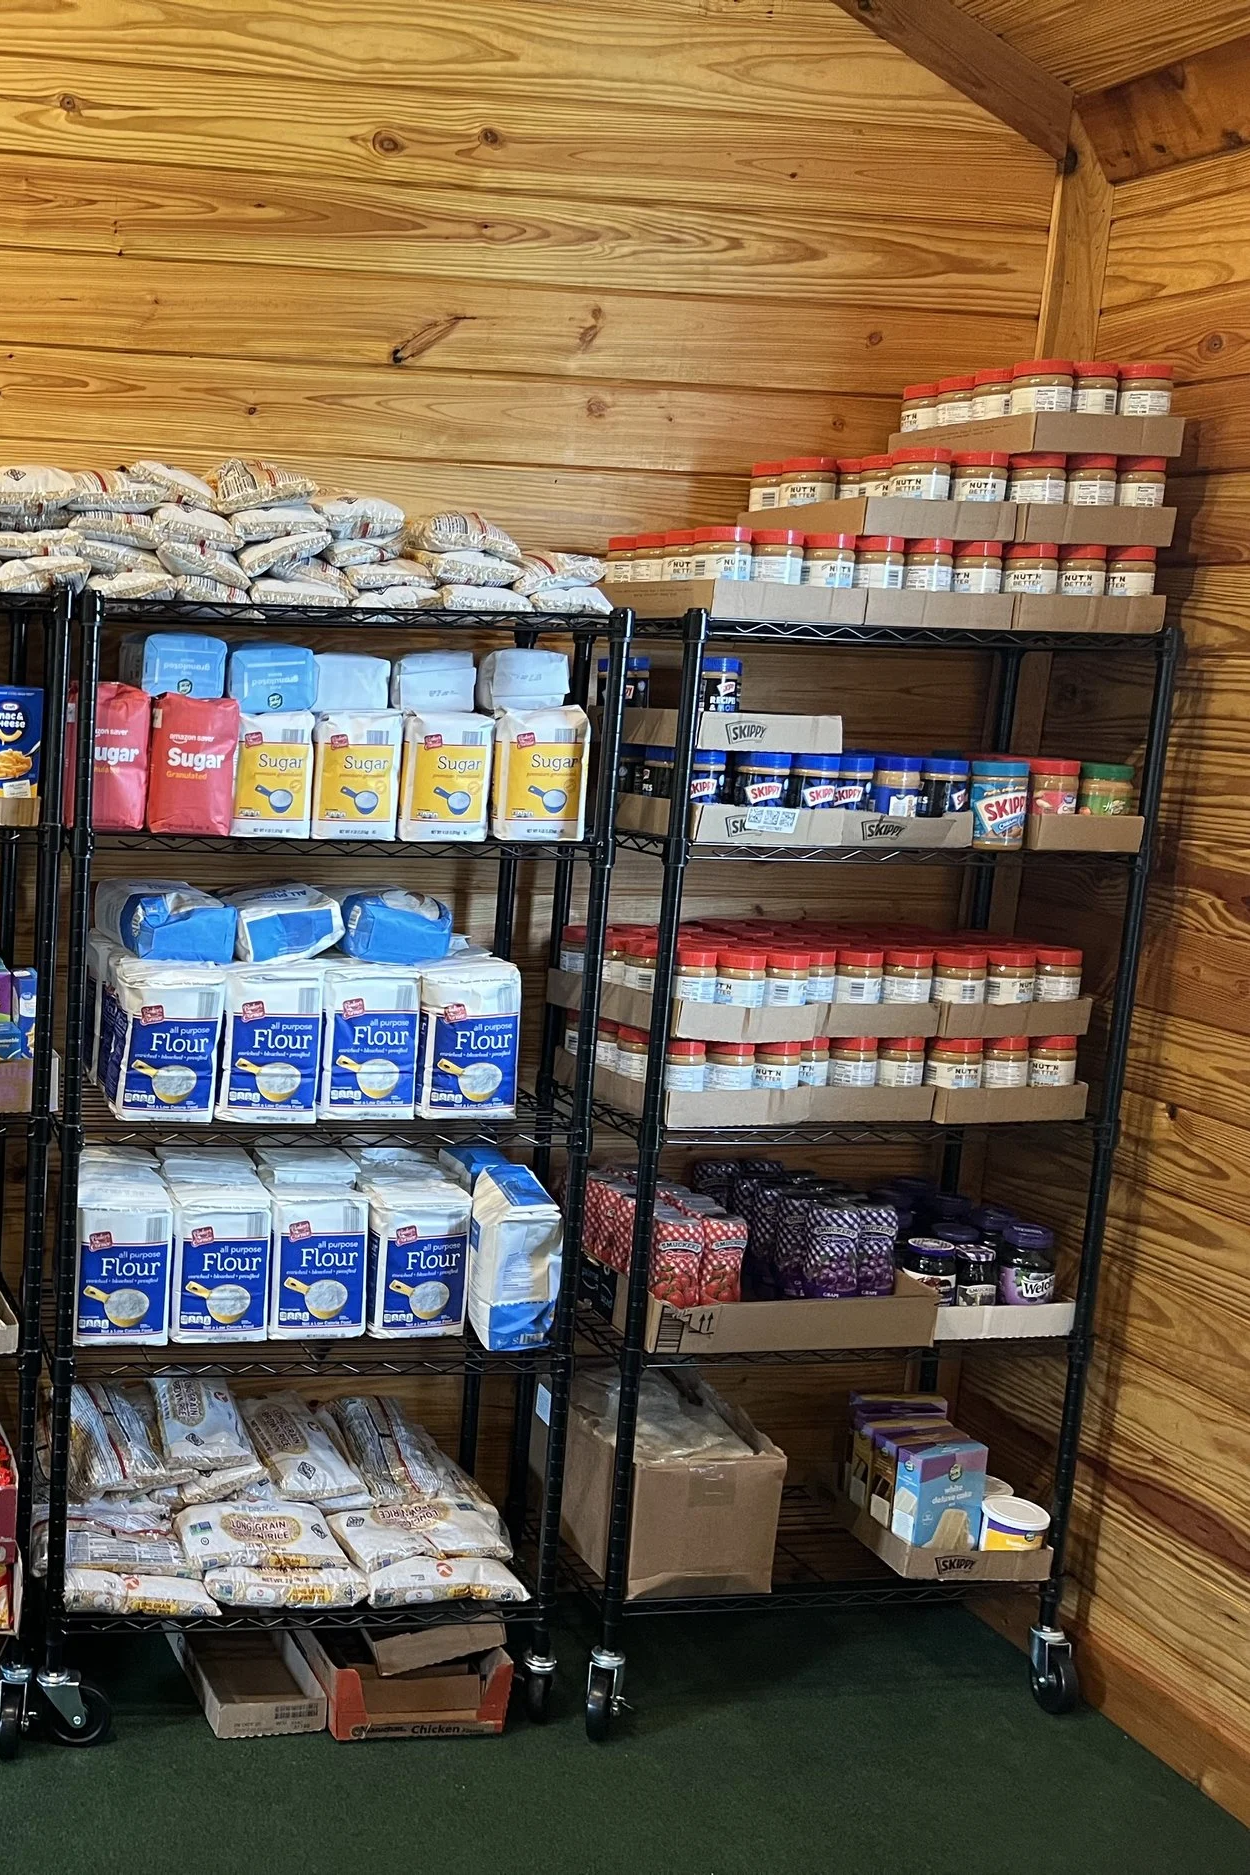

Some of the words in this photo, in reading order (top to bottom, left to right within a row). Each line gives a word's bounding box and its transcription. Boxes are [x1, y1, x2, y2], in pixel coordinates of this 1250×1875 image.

[170, 734, 195, 742] amazon
[732, 724, 767, 740] SKIPPY
[95, 747, 139, 765] ugar
[168, 748, 225, 771] Sugar
[258, 754, 303, 771] Sugar
[344, 756, 389, 772] Sugar
[438, 756, 482, 772] Sugar
[532, 754, 578, 771] Sugar
[166, 771, 207, 780] Granulated
[751, 786, 780, 799] SKIPPY
[809, 788, 834, 801] SKIPP
[984, 797, 1026, 821] SKIPP
[867, 823, 906, 837] SKIPPY
[180, 1027, 210, 1035] purpose
[282, 1024, 312, 1032] purpose
[380, 1020, 409, 1028] purpose
[150, 1033, 209, 1052] Flour
[253, 1030, 312, 1049] Flour
[353, 1026, 409, 1045] Flour
[455, 1032, 513, 1049] Flour
[130, 1252, 161, 1261] purpose
[203, 1253, 262, 1272] Flour
[406, 1252, 460, 1270] Flour
[101, 1258, 161, 1276] Flour
[255, 1521, 286, 1531] GRAIN
[941, 1558, 975, 1570] SKIPPY
[411, 1724, 460, 1734] Chicken
